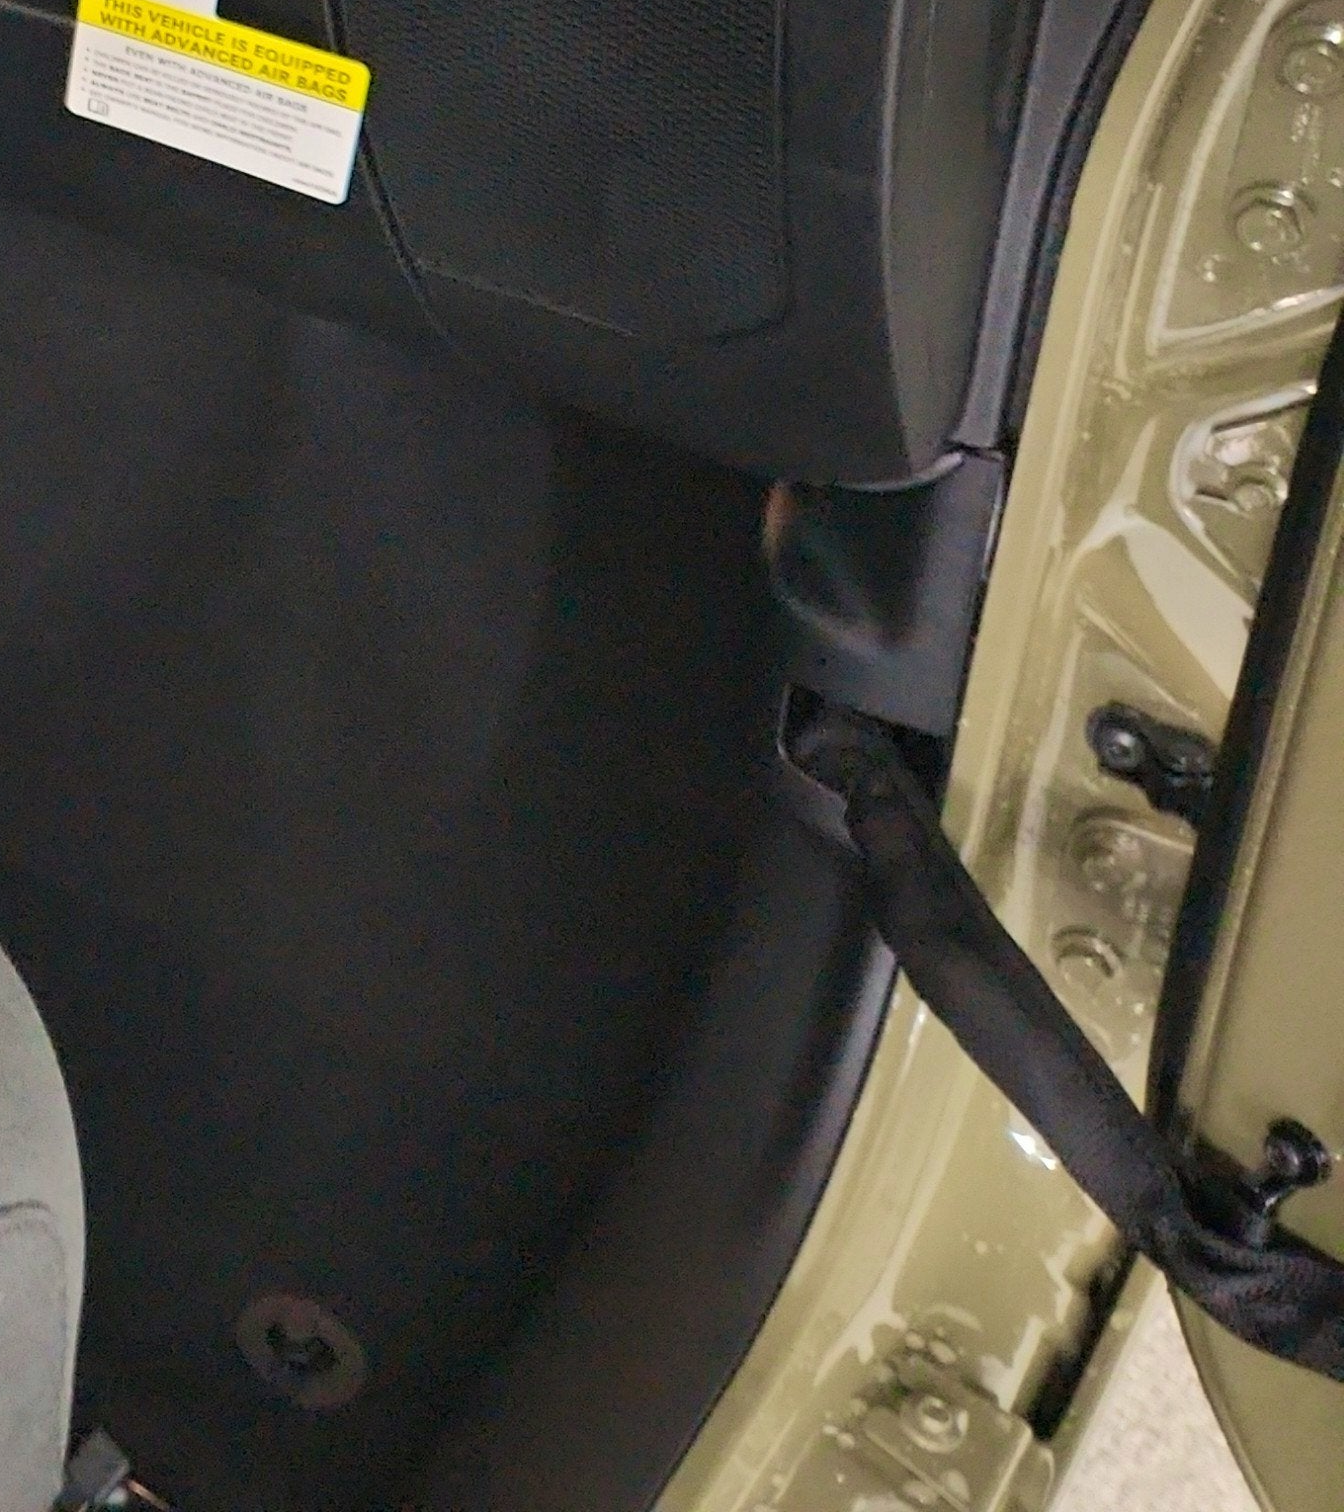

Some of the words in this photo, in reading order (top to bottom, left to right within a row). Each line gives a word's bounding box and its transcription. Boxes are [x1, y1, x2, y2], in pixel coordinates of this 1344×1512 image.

[100, 11, 147, 36] WITH
[151, 29, 253, 71] ADVANCED
[258, 65, 290, 83] AIR
[296, 75, 348, 102] BAGS
[148, 9, 226, 46] VEHICLE
[231, 38, 248, 53] IS
[253, 44, 351, 85] EQUIPPED
[190, 67, 252, 93] ADVANCED
[255, 88, 273, 101] AIR
[277, 96, 307, 112] BAGS
